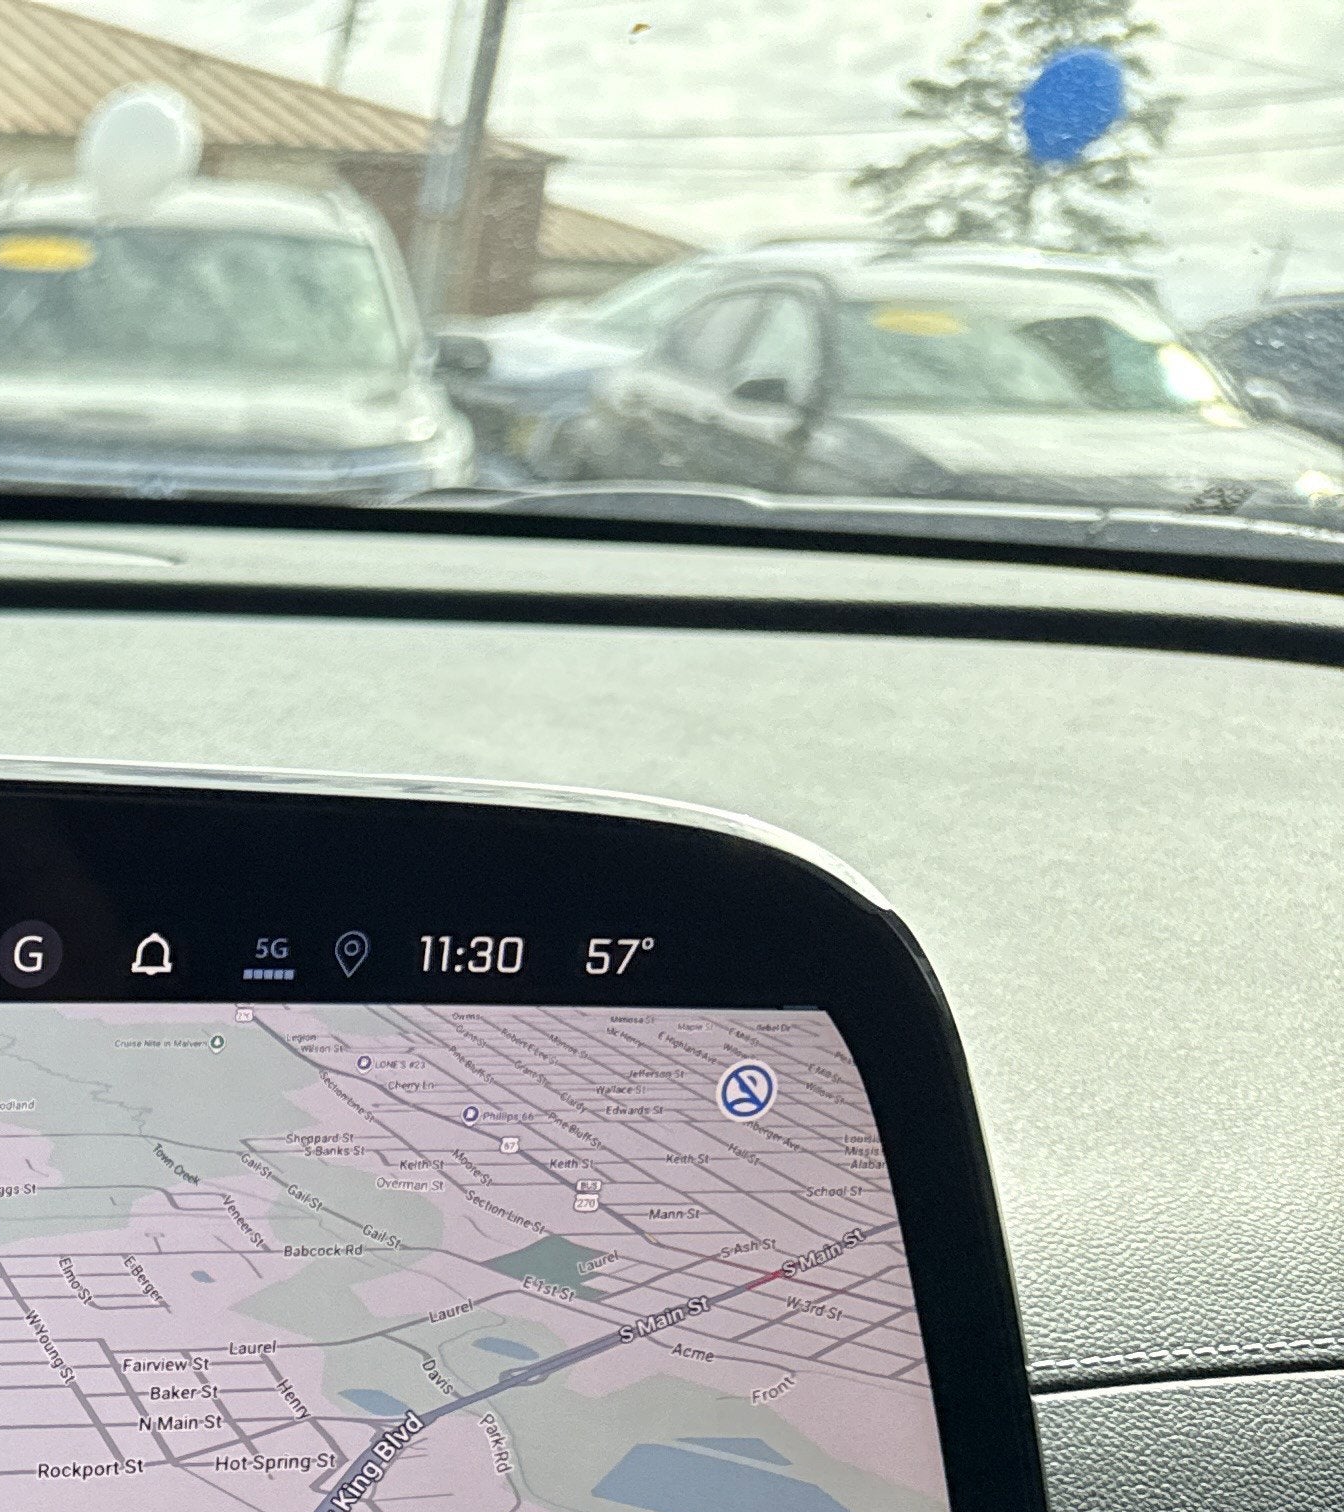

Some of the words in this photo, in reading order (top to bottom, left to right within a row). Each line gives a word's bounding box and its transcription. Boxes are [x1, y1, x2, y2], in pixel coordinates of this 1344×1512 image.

[14, 935, 44, 973] G
[255, 937, 290, 959] 5G
[420, 935, 524, 974] 11:30
[586, 937, 655, 975] 57°
[629, 1069, 671, 1079] Jefferson
[673, 1069, 684, 1078] St
[606, 1106, 650, 1115] Edwards
[652, 1105, 664, 1115] St
[153, 1143, 175, 1169] Town
[171, 1161, 200, 1186] Creek
[21, 1183, 37, 1195] St
[376, 1177, 428, 1190] Overman
[431, 1180, 444, 1191] St
[806, 1186, 845, 1198] School
[850, 1186, 862, 1197] St
[466, 1190, 506, 1218] Section
[506, 1210, 531, 1228] Line
[531, 1220, 546, 1234] St
[649, 1209, 683, 1220] Mann
[687, 1209, 700, 1219] St
[284, 1245, 341, 1257] Babcock
[344, 1244, 363, 1255] Rd
[429, 1299, 474, 1323] Laurel
[618, 1327, 635, 1345] S
[636, 1306, 685, 1337] Main
[686, 1294, 711, 1316] St
[229, 1341, 276, 1355] Laurel
[672, 1343, 715, 1363] Acme
[123, 1359, 187, 1373] Fairview
[192, 1358, 209, 1371] St
[422, 1359, 455, 1395] Davis
[150, 1386, 196, 1400] Baker
[200, 1385, 218, 1398] St
[276, 1378, 311, 1419] Henry
[139, 1417, 153, 1431] N
[157, 1417, 196, 1431] Main
[203, 1415, 222, 1429] St
[373, 1411, 424, 1465] Blvd
[38, 1462, 119, 1480] Rockport
[125, 1459, 143, 1474] St
[216, 1457, 247, 1471] Hot
[253, 1456, 311, 1474] Spring
[317, 1454, 336, 1468] St
